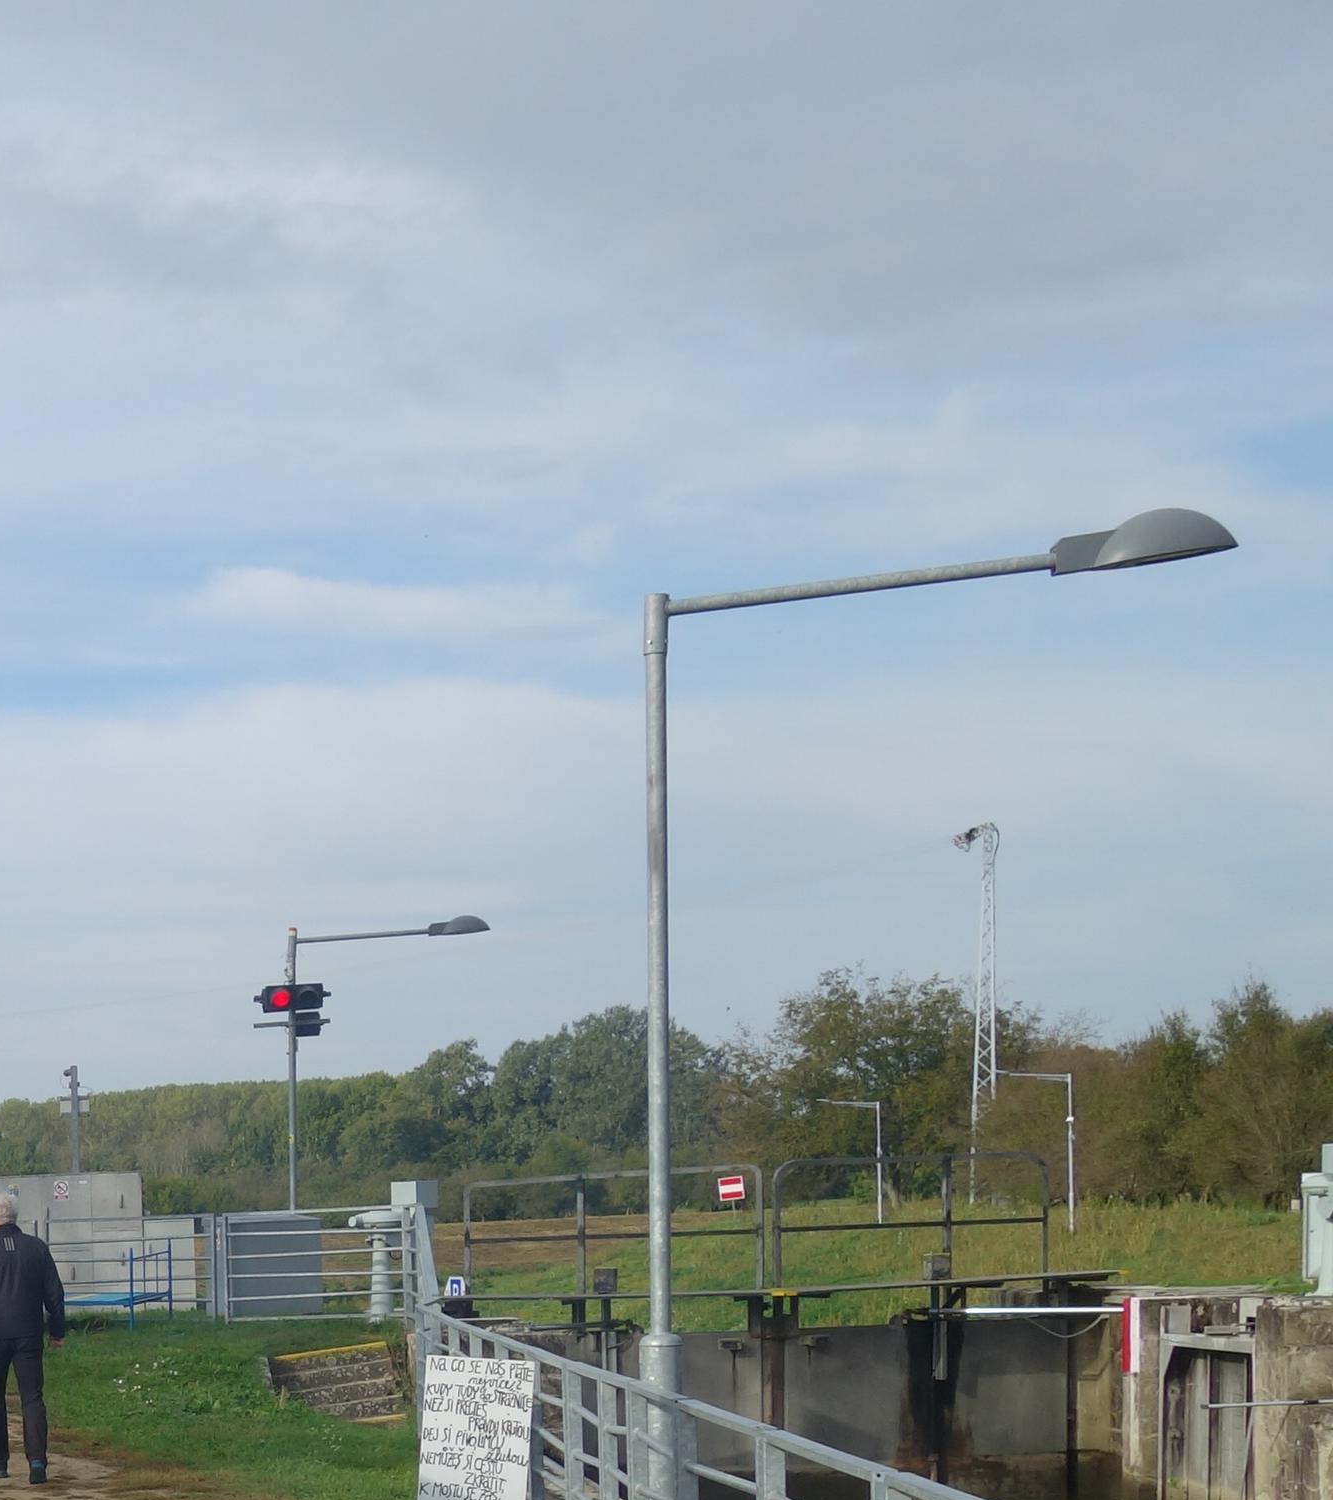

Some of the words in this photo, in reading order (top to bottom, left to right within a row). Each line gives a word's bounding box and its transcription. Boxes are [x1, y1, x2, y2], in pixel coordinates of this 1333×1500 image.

[469, 1360, 482, 1375] SE
[426, 1383, 454, 1398] KUDY
[455, 1384, 480, 1401] TUDY
[423, 1427, 439, 1442] DEJ
[419, 1482, 431, 1496] K
[432, 1481, 464, 1499] MOSTU
